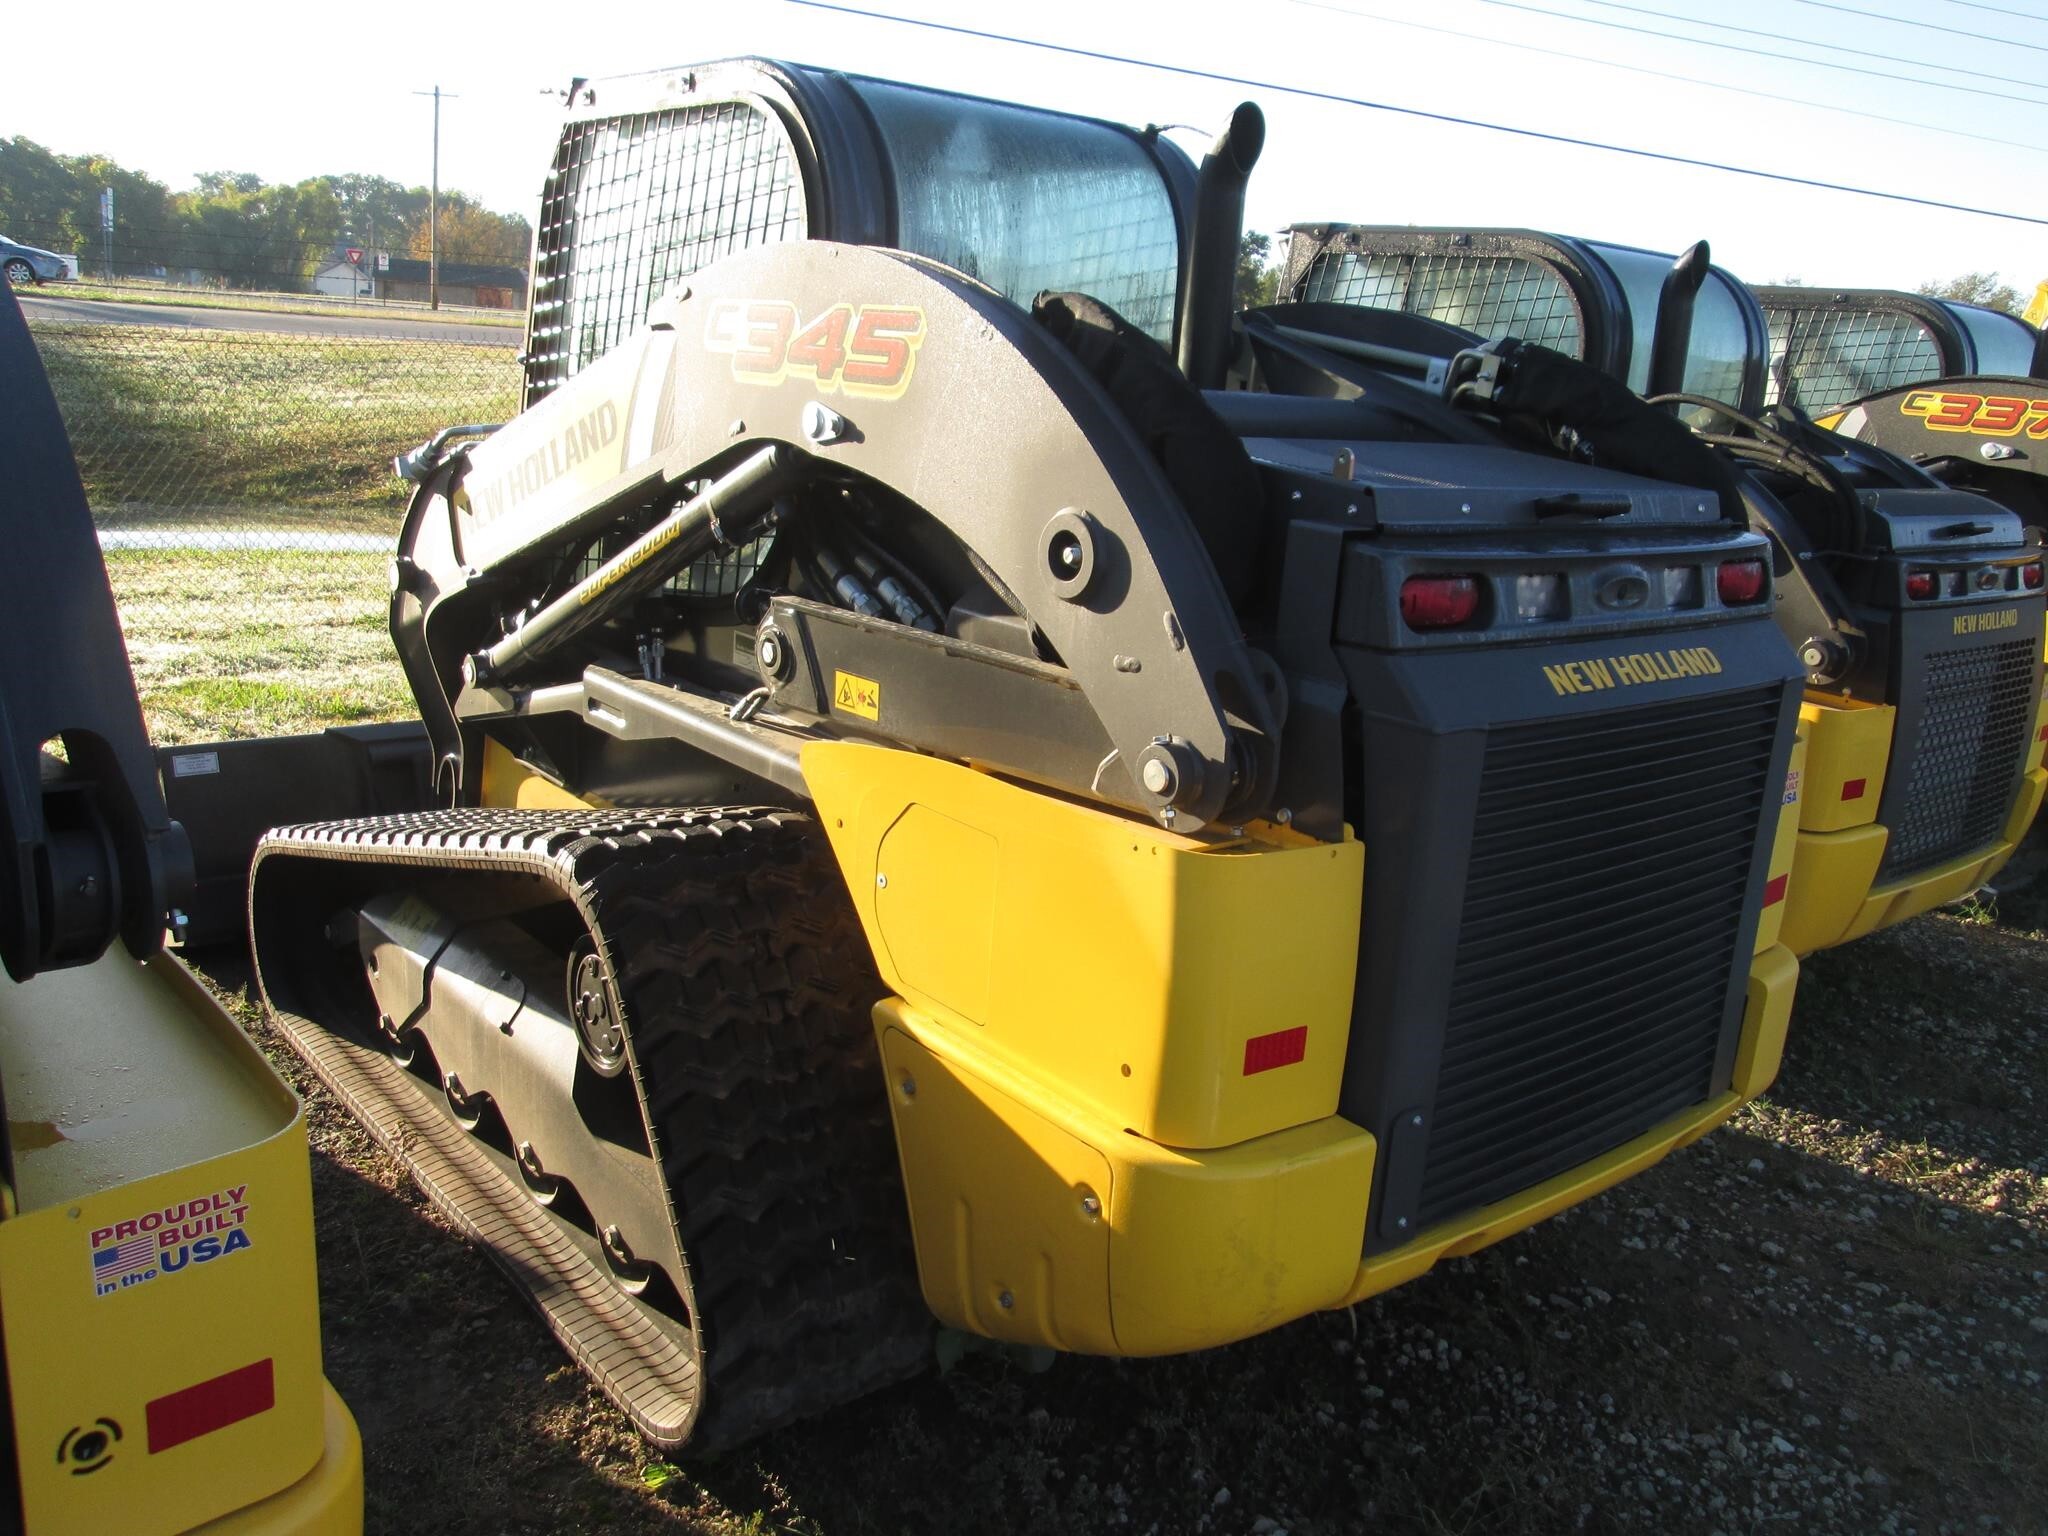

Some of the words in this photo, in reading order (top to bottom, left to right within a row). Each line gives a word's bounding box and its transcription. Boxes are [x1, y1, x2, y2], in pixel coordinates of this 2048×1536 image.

[704, 300, 927, 400] C345
[508, 400, 618, 501] HOLLAND
[1953, 614, 1977, 635] NEW
[1978, 608, 2018, 632] HOLLAND
[1542, 659, 1615, 696] NEW
[1609, 647, 1722, 686] HOLLAND
[91, 1185, 247, 1249] PROUDLY
[158, 1205, 249, 1248] BUILT
[97, 1282, 117, 1296] in
[121, 1269, 158, 1288] the
[160, 1228, 251, 1273] USA
